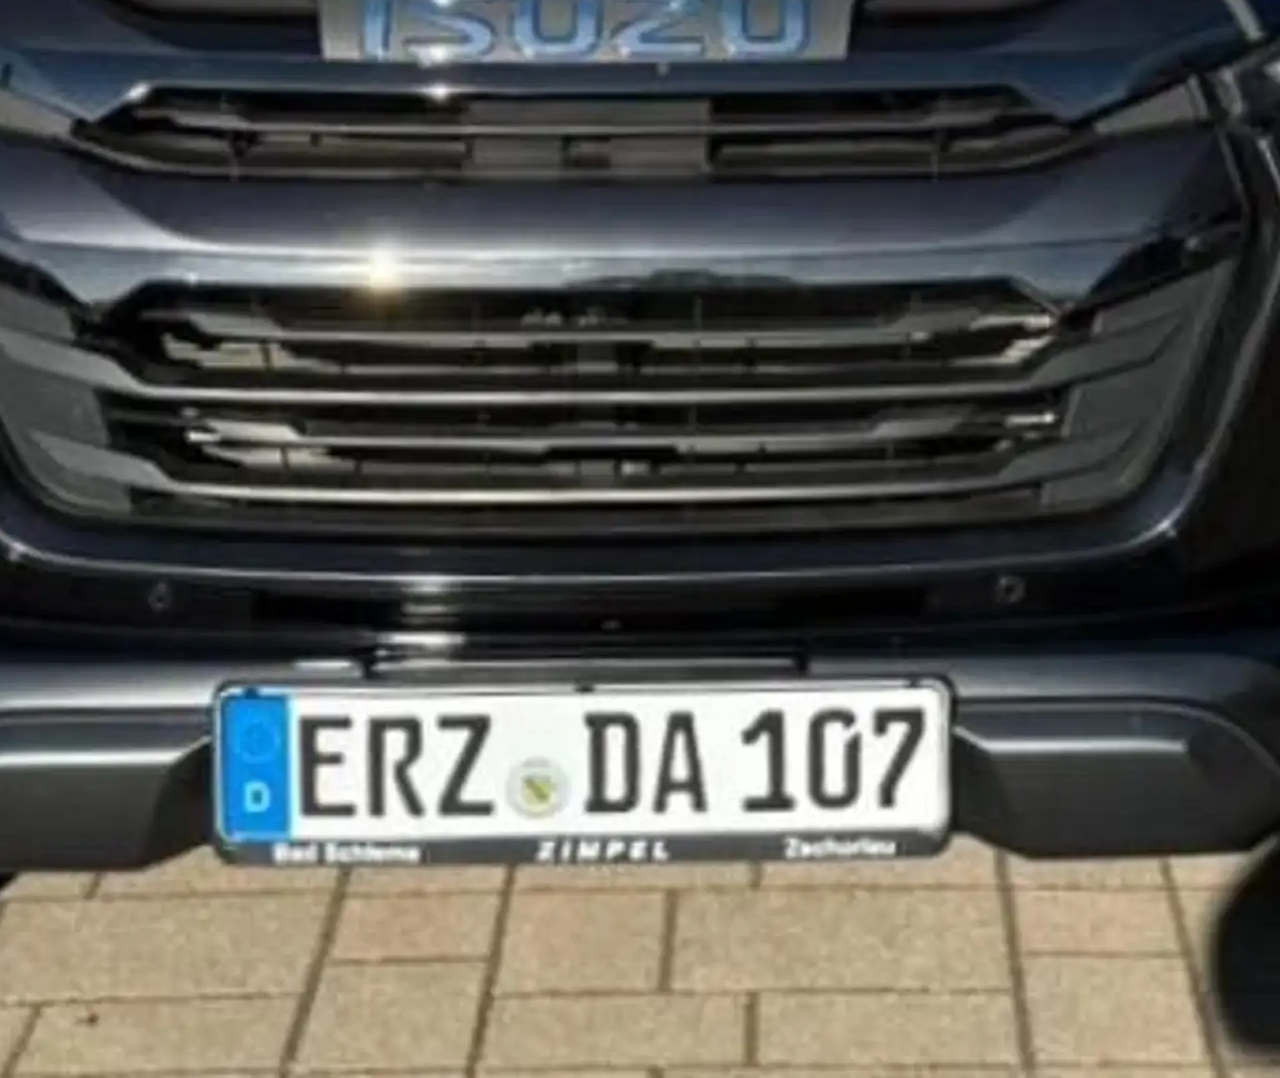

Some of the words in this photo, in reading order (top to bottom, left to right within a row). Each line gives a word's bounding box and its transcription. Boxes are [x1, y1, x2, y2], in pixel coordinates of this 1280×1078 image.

[298, 714, 495, 817] ERZ
[583, 711, 708, 813] DA
[740, 707, 926, 811] 107
[243, 781, 270, 813] D
[535, 838, 671, 862] ZIMPEL
